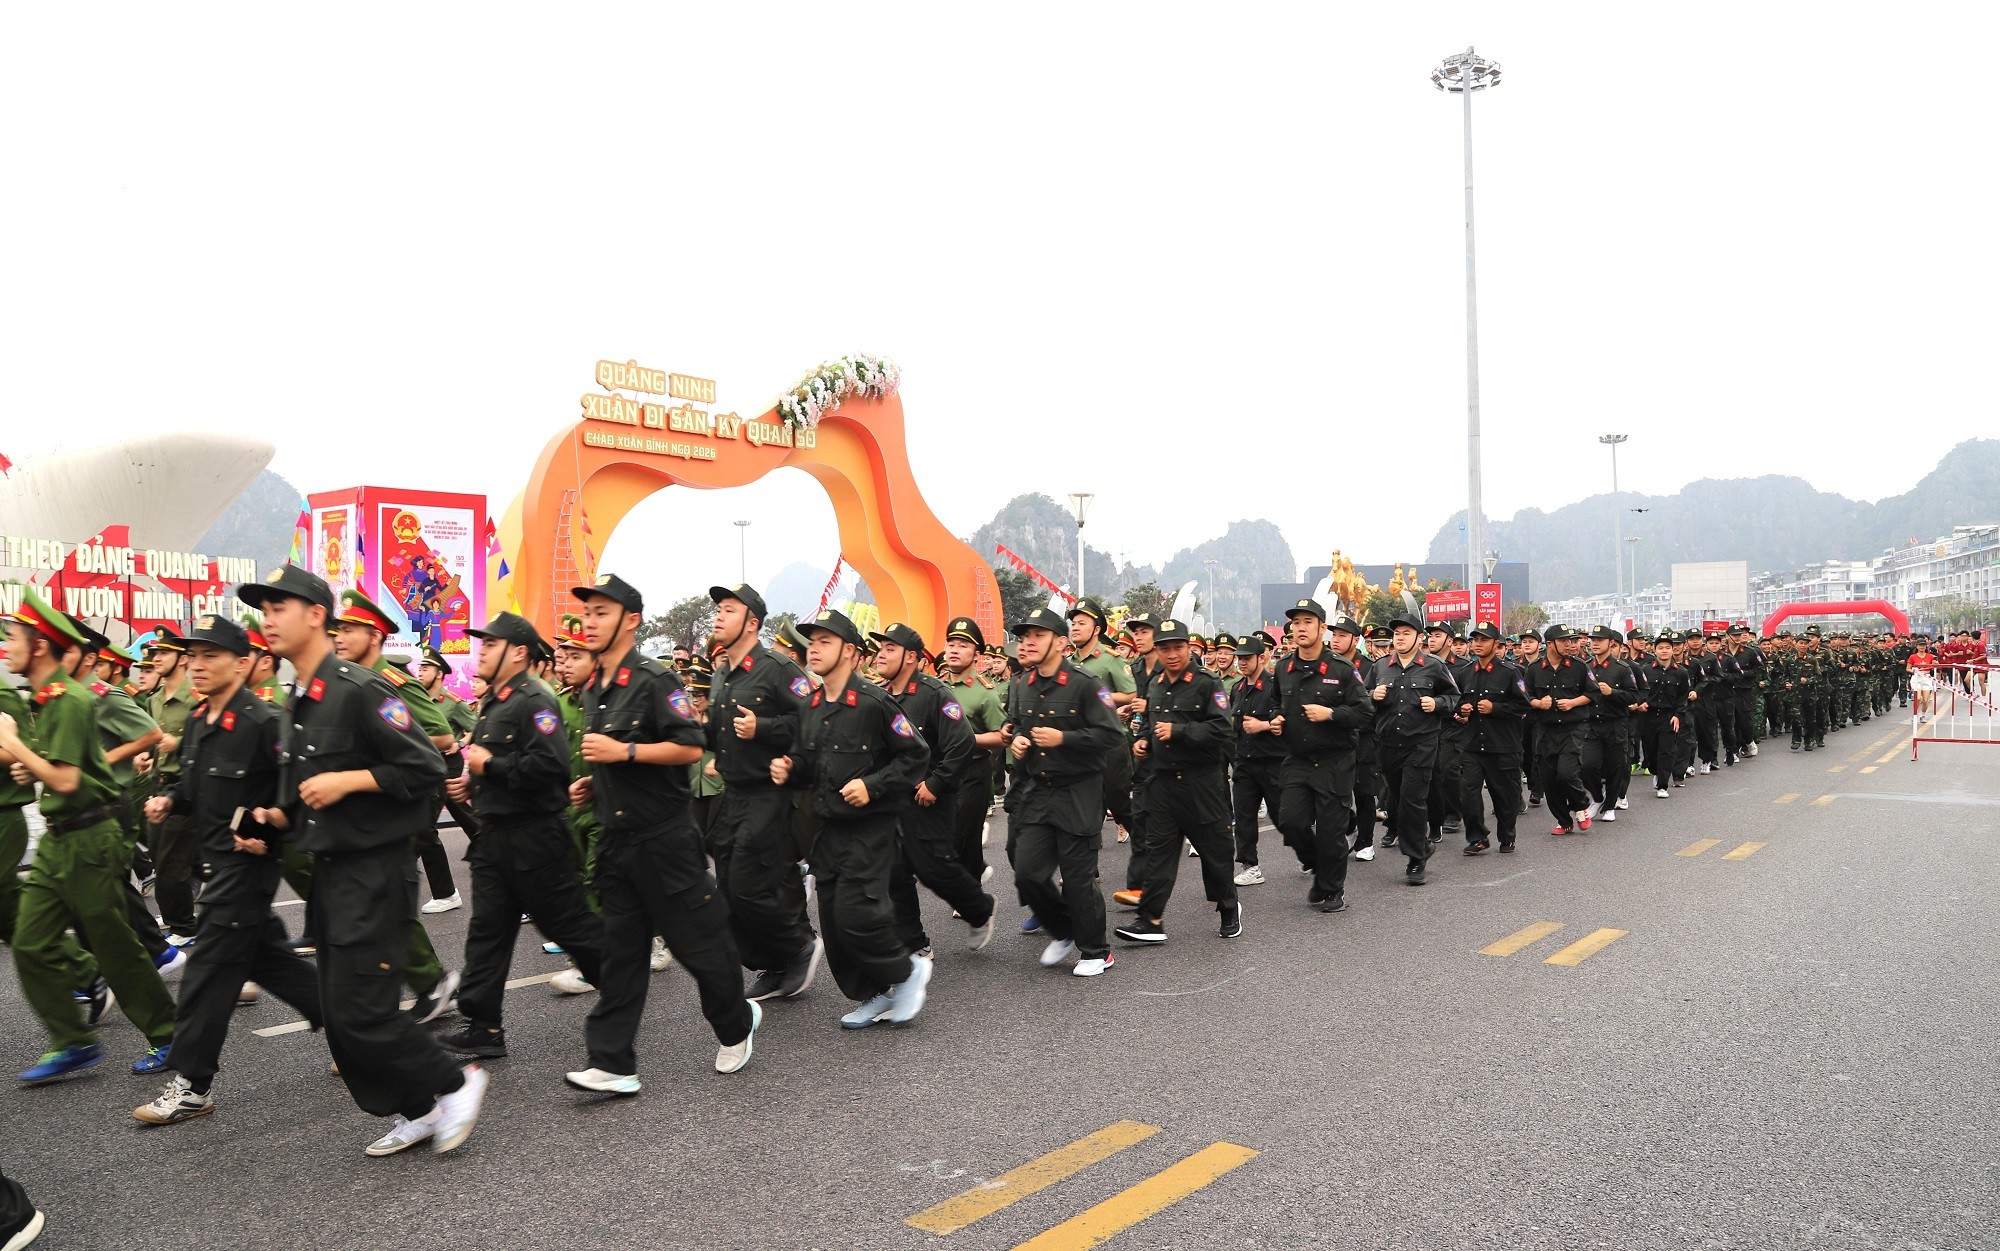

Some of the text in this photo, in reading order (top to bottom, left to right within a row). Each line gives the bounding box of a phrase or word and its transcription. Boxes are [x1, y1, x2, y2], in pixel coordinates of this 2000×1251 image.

[599, 361, 716, 403] QUẢNG NINH
[584, 394, 639, 424] XUÂN
[644, 404, 665, 428] DI
[670, 404, 713, 436] SẢN,
[718, 412, 743, 438] KỲ
[747, 420, 793, 446] QUAN
[586, 431, 716, 459] CHÀO XUÂN BÍNH NGỌ 2026
[7, 534, 257, 584] THEO ĐẢNG QUANG VINH
[65, 586, 124, 619] VƯƠN
[133, 587, 184, 621] MÌNH
